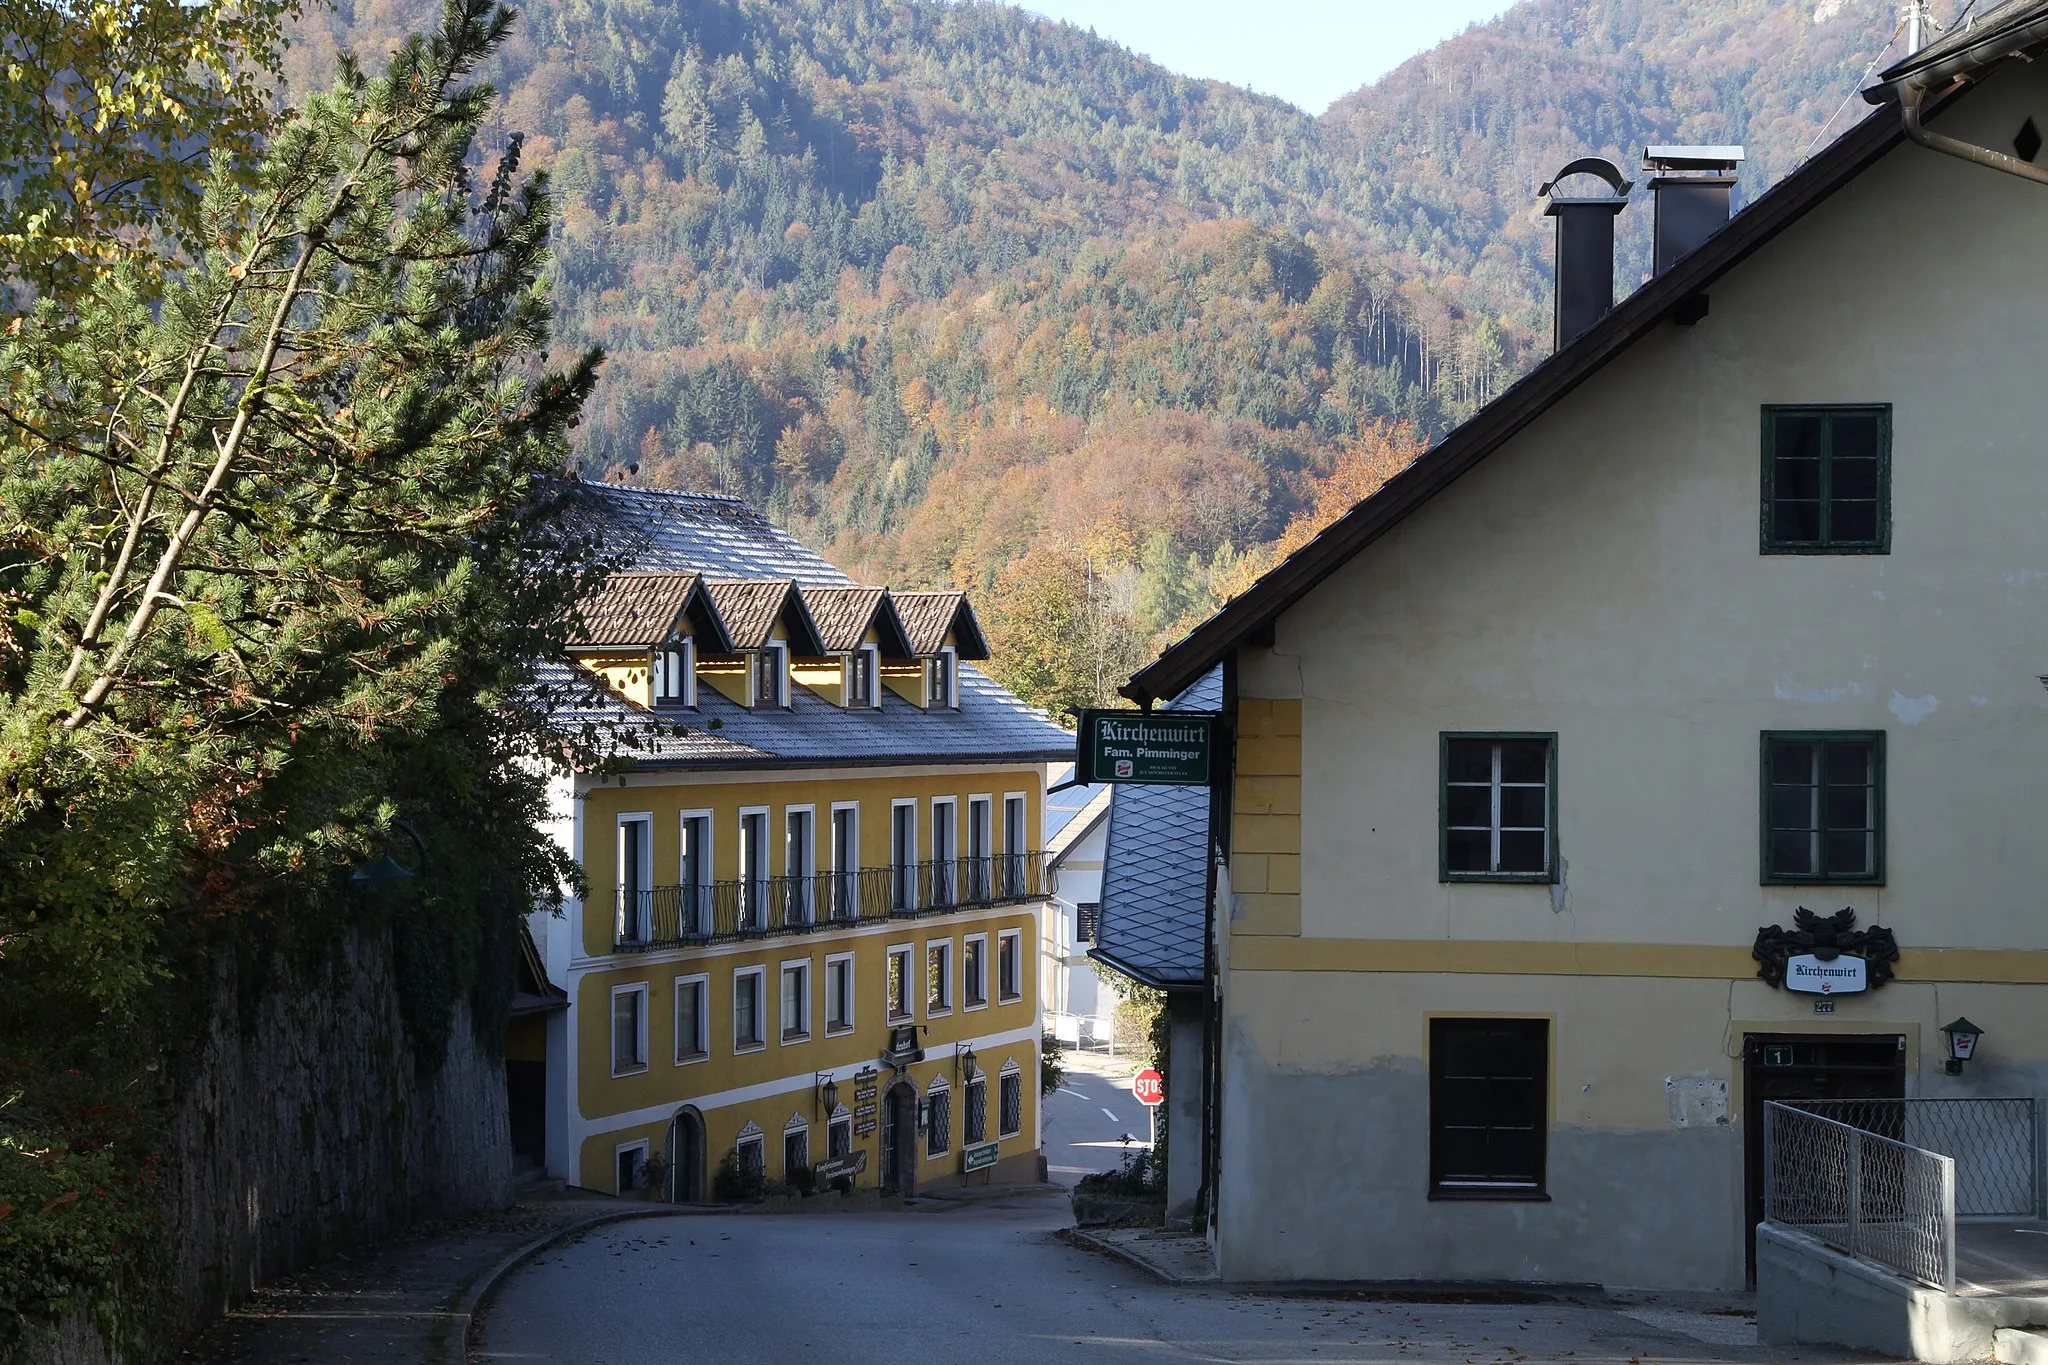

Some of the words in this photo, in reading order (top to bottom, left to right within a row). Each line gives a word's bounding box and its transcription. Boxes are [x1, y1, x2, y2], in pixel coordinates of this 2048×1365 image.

[1101, 720, 1205, 746] Kirchenwirt
[1104, 746, 1133, 757] Fam.
[1136, 747, 1201, 761] Pimminger
[1795, 964, 1857, 979] Kirchenwirt
[1816, 1001, 1833, 1012] 277
[1774, 1051, 1781, 1064] 1
